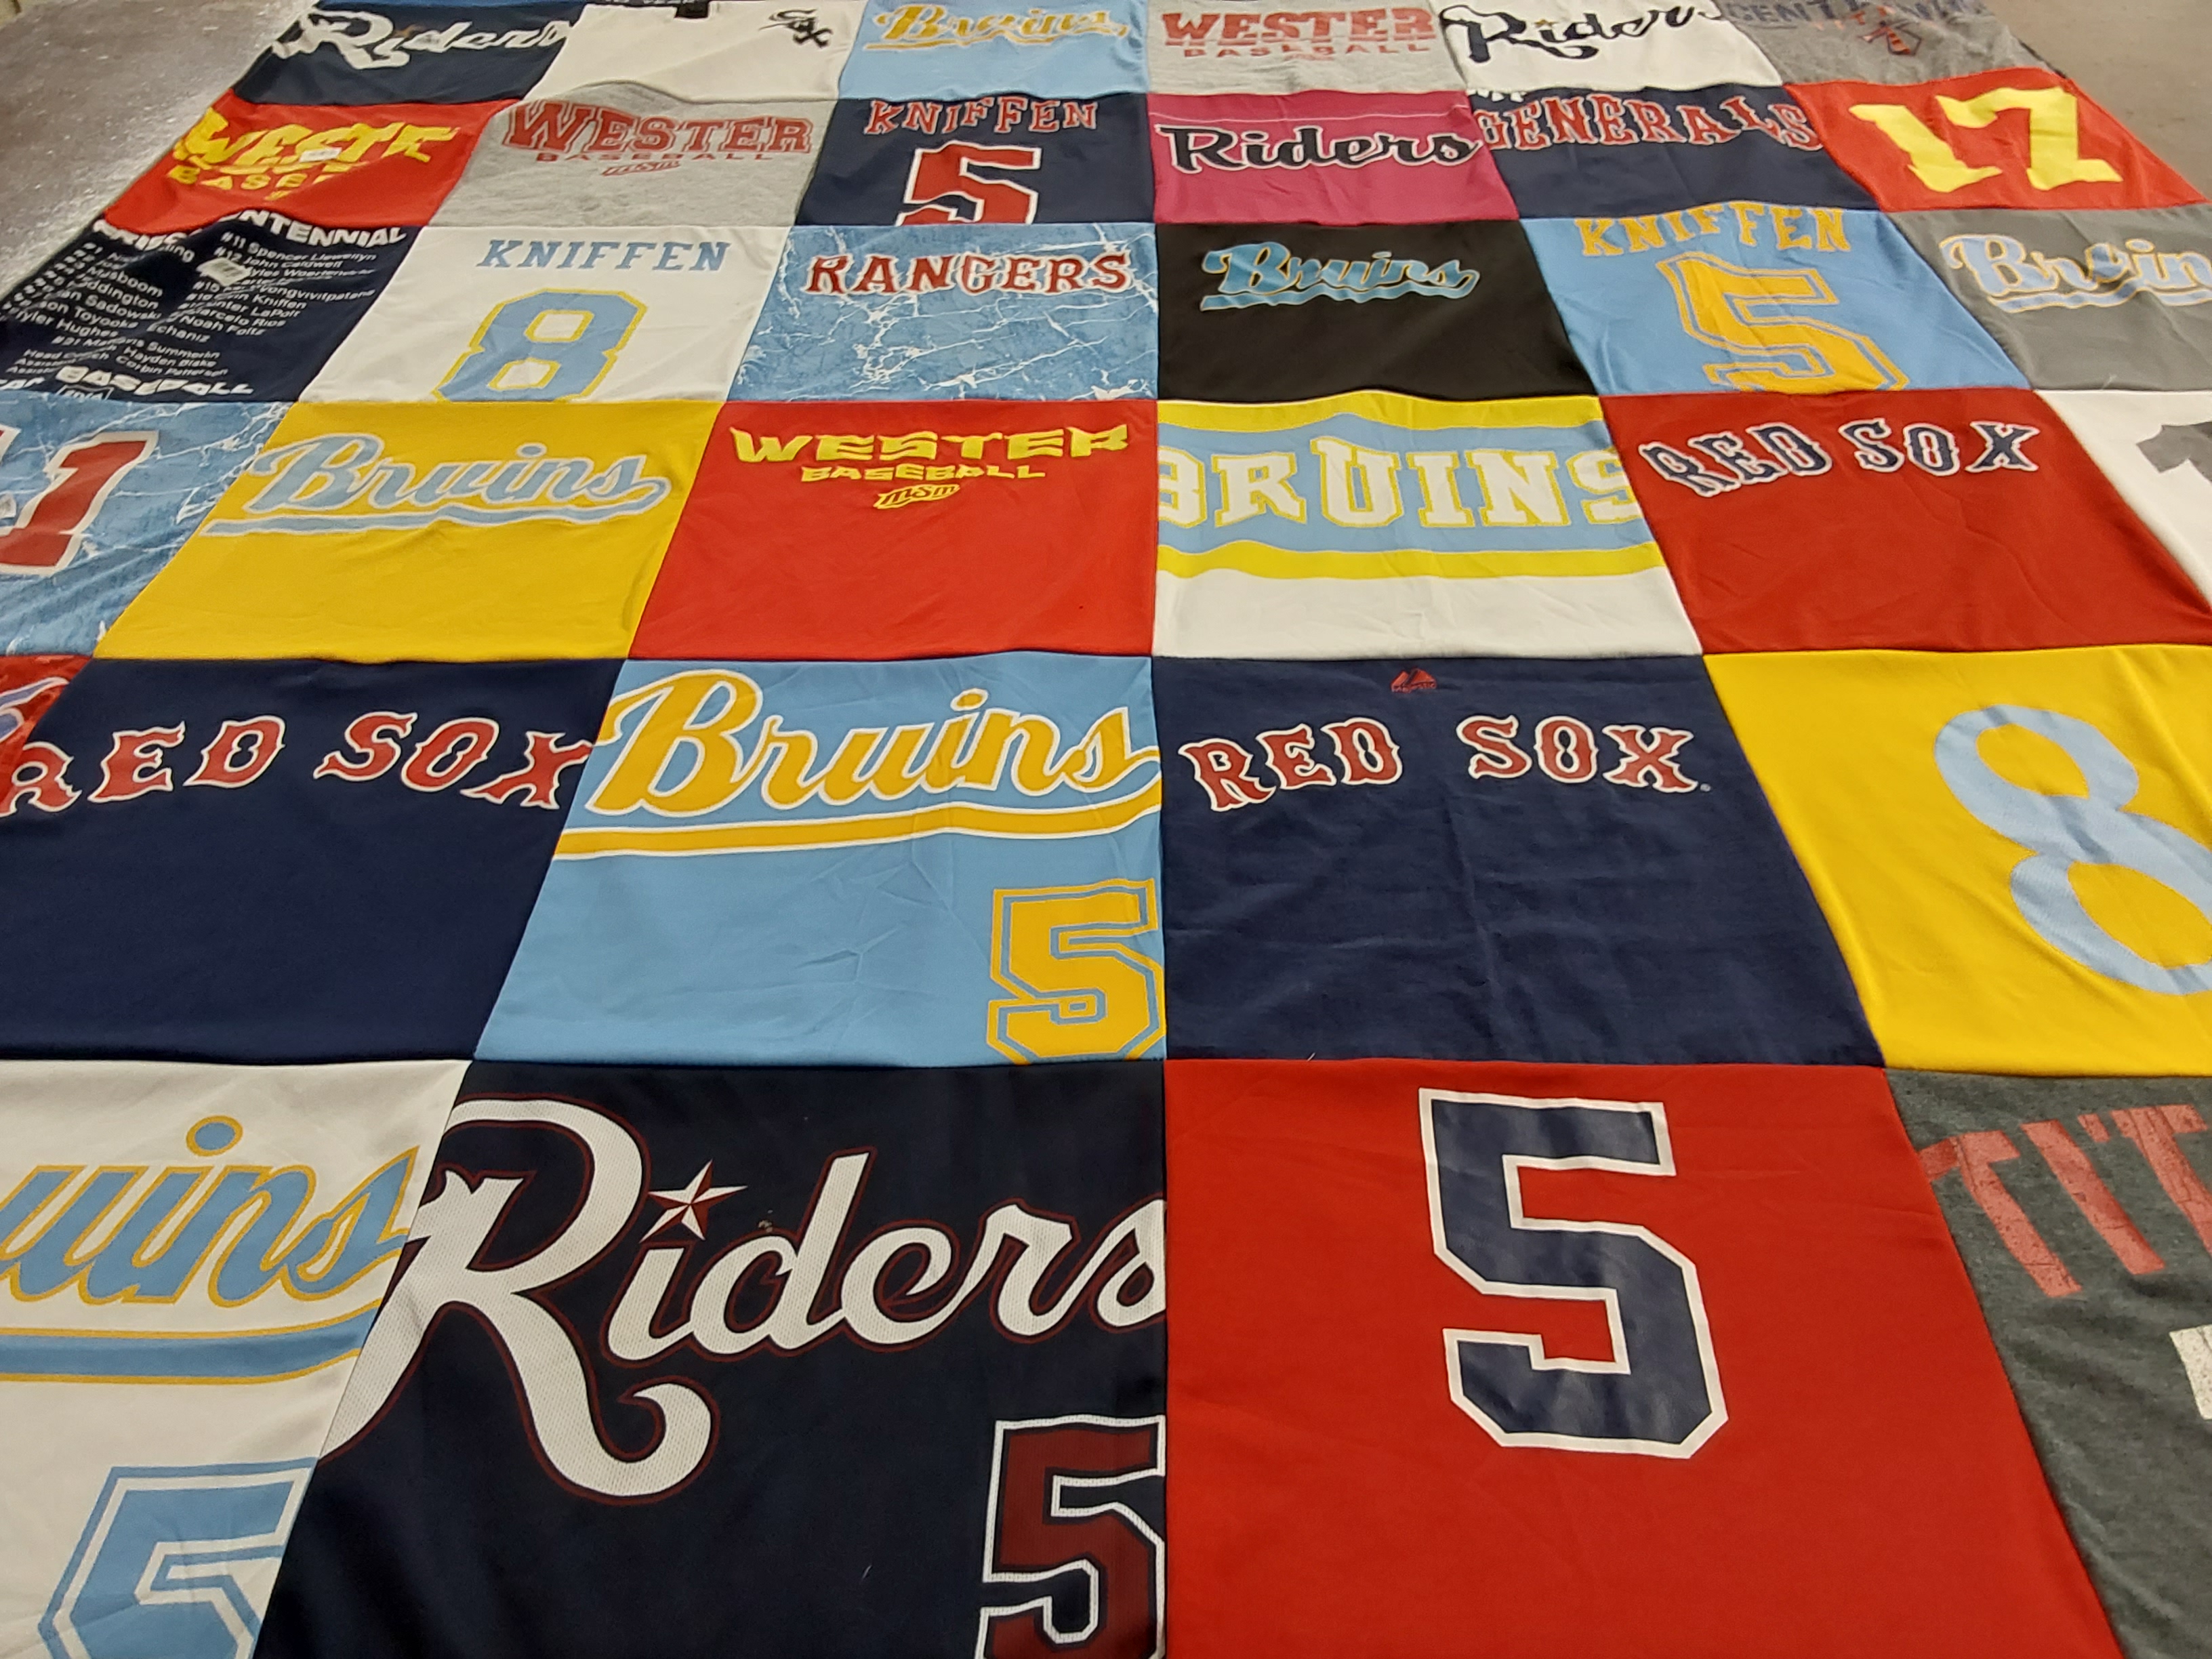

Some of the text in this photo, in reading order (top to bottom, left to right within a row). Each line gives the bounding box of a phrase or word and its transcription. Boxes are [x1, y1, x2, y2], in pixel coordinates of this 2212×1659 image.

[1162, 7, 1435, 46] WESTER
[501, 100, 815, 153] WESTER
[535, 153, 774, 162] BASEBALL
[864, 96, 1099, 136] KNIFFEN
[1153, 124, 1483, 174] Riders
[1473, 94, 1824, 150] GENERALS
[895, 140, 1043, 226] 5
[476, 239, 731, 272] KNIFFEN
[1573, 201, 1852, 256] KNIFFEN
[798, 251, 1134, 296] RANGERS
[1200, 241, 1481, 305] Bruins
[431, 287, 649, 403] 8
[1656, 250, 1910, 395] 5
[234, 432, 673, 525] Bruins
[729, 424, 1129, 462] WESTER
[801, 463, 1046, 483] BASEBALL
[1158, 435, 1647, 529] BRUINS
[1638, 417, 2040, 498] RED SOX
[0, 711, 596, 817] RED SOX
[583, 668, 1163, 830] Bruins
[1178, 714, 1699, 813] RED SOX
[1933, 703, 2212, 997] 8
[986, 878, 1166, 1065] 5
[316, 1092, 1166, 1506] Riders
[1418, 1087, 1729, 1460] 5
[975, 1414, 1166, 1659] 5
